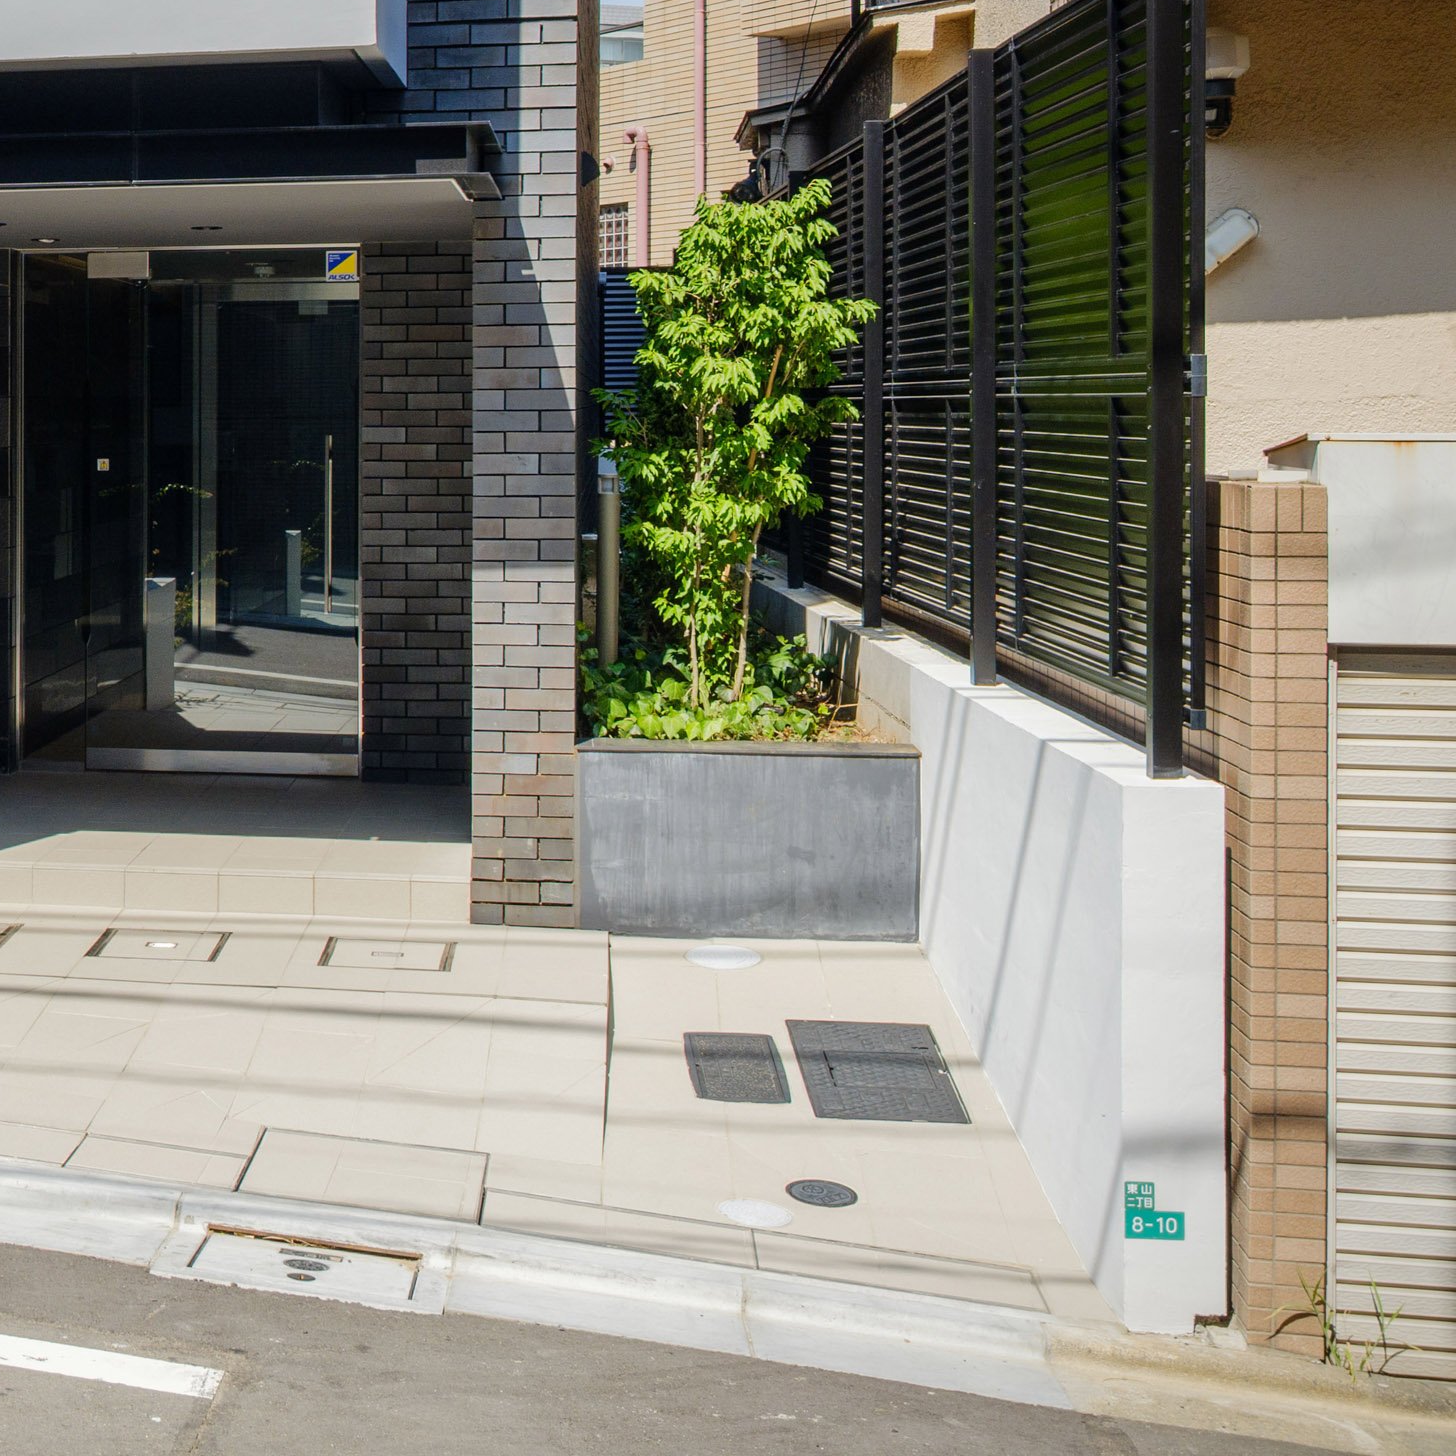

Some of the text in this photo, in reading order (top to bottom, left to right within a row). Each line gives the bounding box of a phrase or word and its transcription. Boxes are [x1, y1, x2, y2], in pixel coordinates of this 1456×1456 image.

[1127, 1184, 1152, 1194] 東山
[1127, 1197, 1153, 1208] 二丁目
[1131, 1216, 1177, 1233] 8-10
